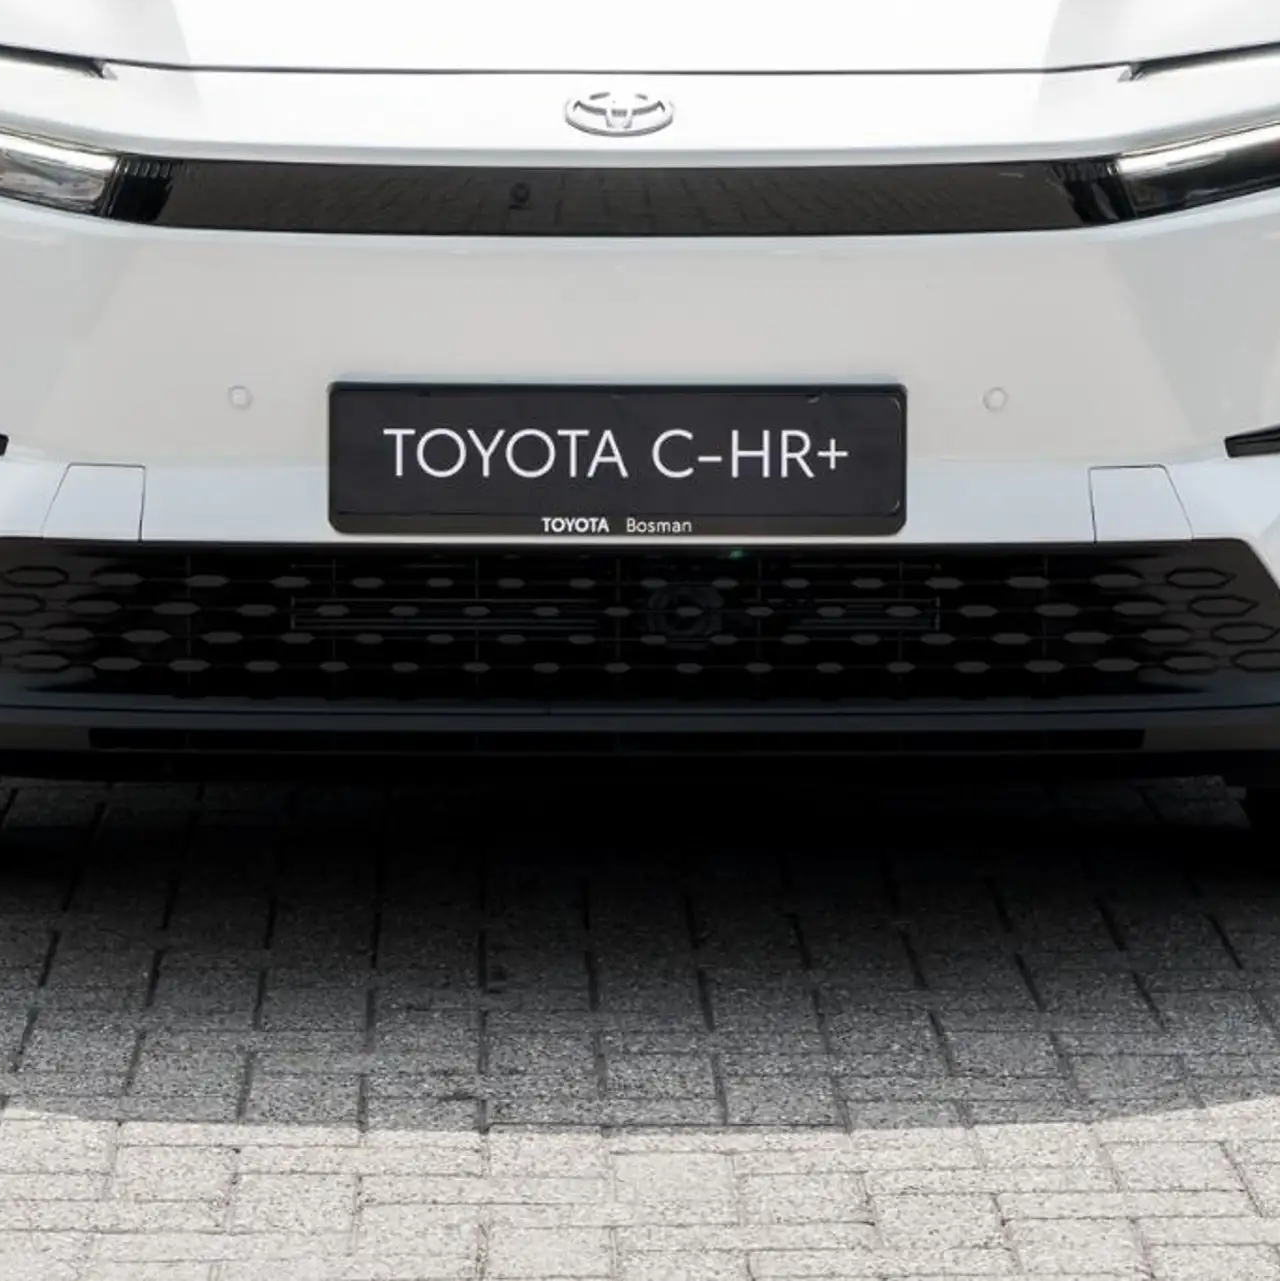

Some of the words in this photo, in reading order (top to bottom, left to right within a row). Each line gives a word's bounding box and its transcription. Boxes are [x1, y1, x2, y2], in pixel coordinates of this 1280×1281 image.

[382, 428, 628, 479] TOYOTA
[651, 428, 849, 479] C-HR+
[541, 517, 610, 534] TOYOTA
[625, 517, 693, 534] Bosman
